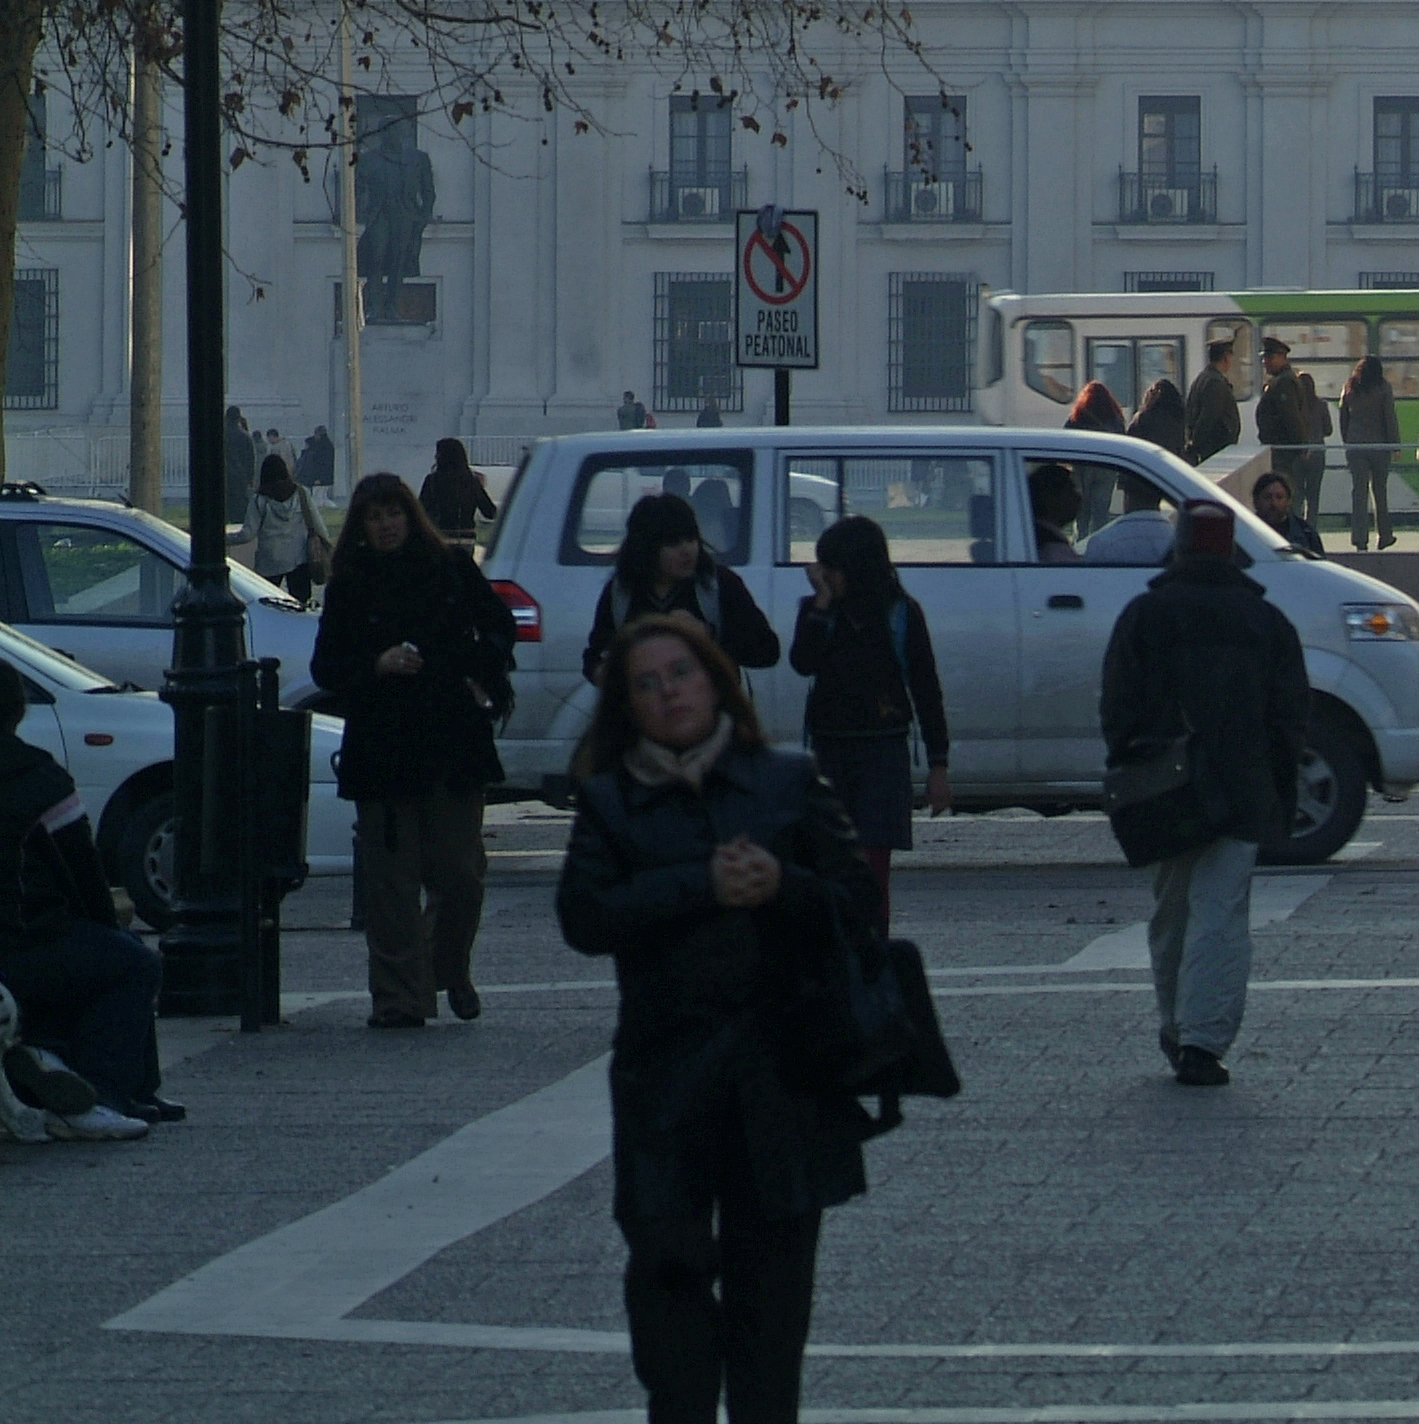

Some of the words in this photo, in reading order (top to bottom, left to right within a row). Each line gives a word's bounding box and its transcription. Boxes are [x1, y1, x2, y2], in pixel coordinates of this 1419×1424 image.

[757, 310, 798, 332] PASEO
[745, 335, 811, 357] PEATONAL
[371, 403, 409, 412] ARTURO
